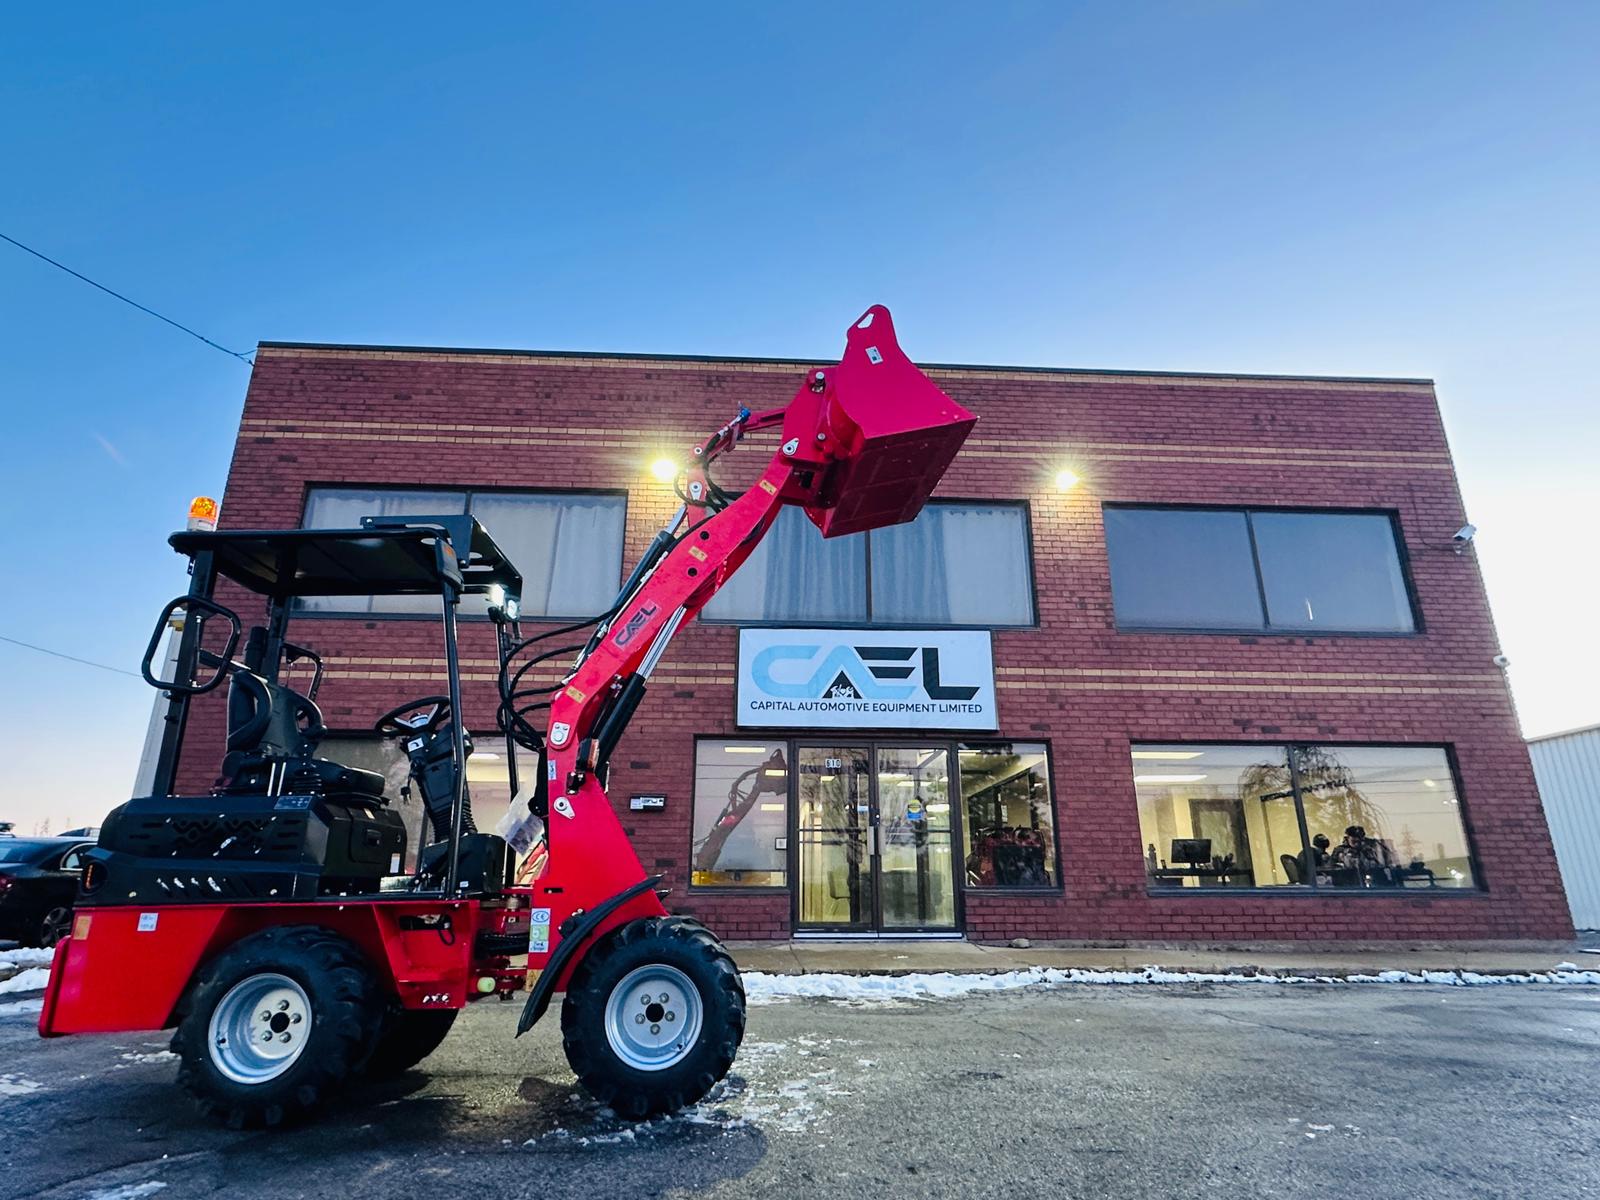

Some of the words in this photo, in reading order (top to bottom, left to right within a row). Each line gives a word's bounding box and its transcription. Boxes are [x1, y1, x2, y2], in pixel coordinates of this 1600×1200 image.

[615, 606, 657, 646] CAEL
[751, 645, 981, 701] CAEL
[750, 701, 796, 711] CAPITAL
[798, 701, 870, 712] AUTOMOTIVE
[873, 703, 937, 713] EQUIPMENT
[939, 704, 983, 713] LIMITED
